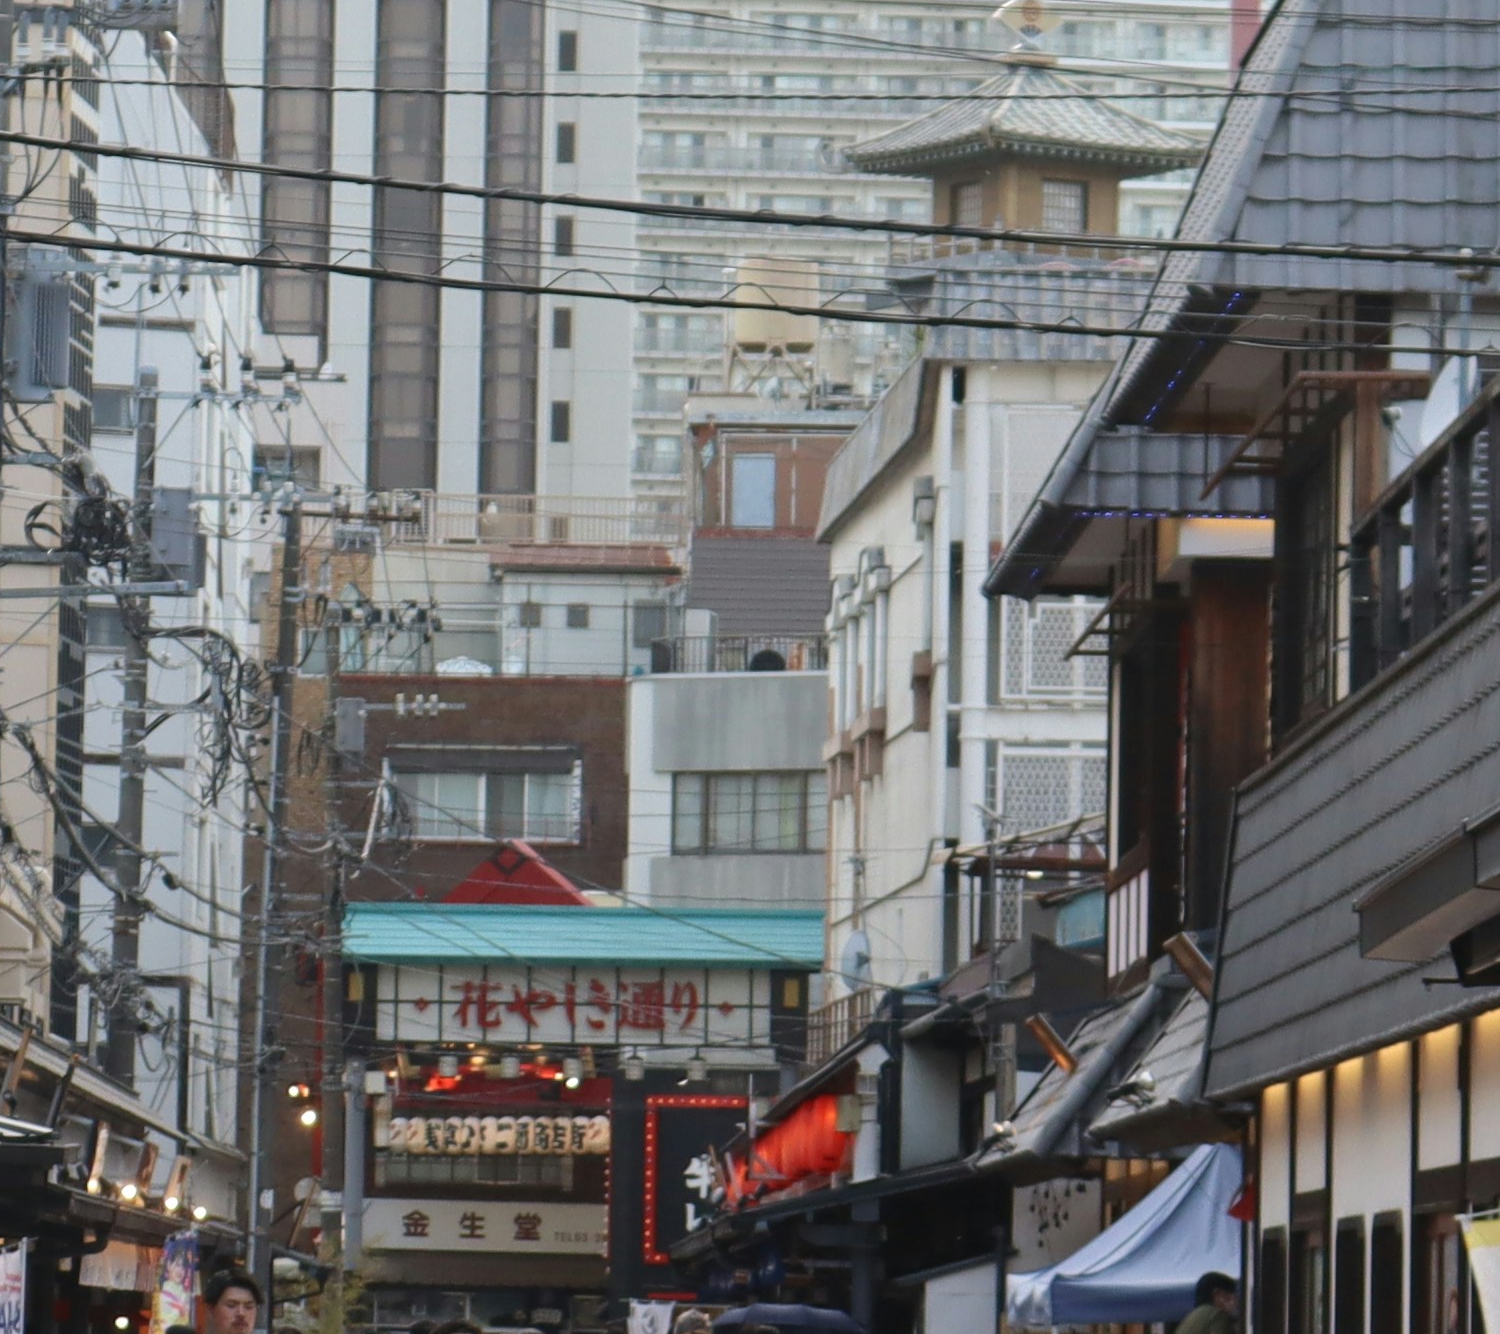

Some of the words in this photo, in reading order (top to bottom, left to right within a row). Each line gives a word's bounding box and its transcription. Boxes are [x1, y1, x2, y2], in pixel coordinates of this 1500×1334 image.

[450, 978, 699, 1030] 花やしき通り
[402, 1209, 543, 1242] 金生堂
